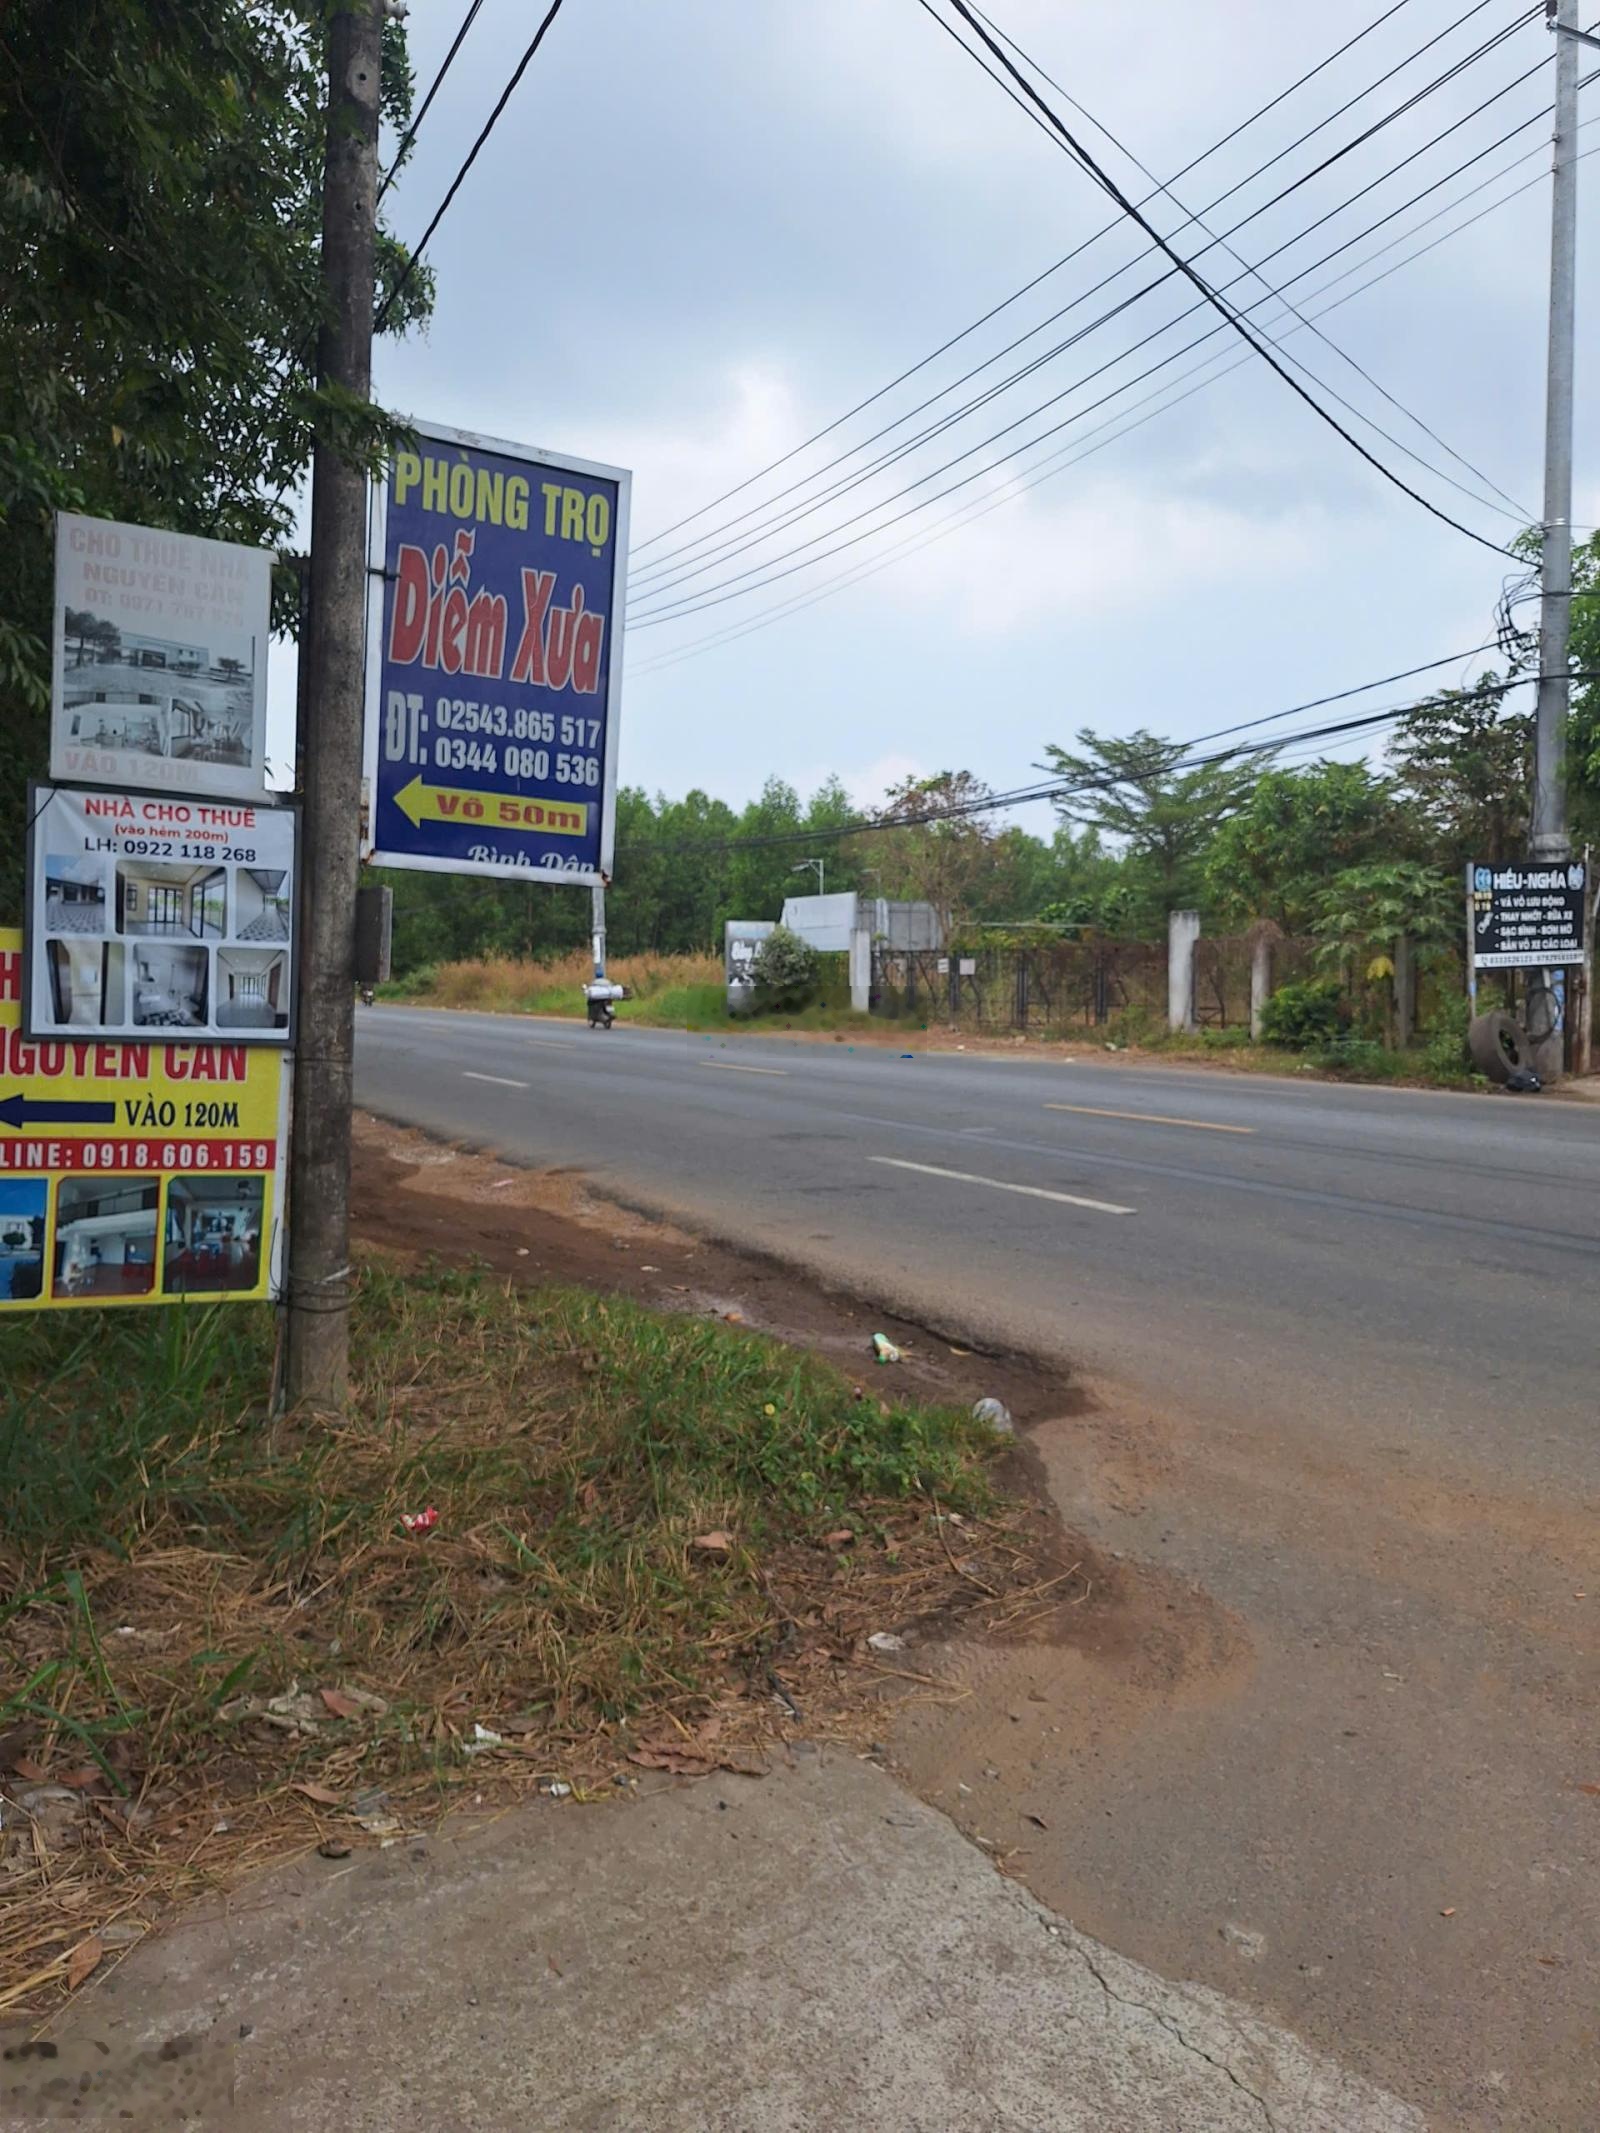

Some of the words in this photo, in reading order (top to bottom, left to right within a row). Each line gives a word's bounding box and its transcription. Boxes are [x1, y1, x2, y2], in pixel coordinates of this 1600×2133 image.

[395, 451, 530, 531] PHÒNG
[541, 483, 610, 557] TRỌ
[388, 527, 508, 680] Diễm
[509, 567, 605, 694] Xưa
[435, 697, 555, 743] 02543.865
[560, 715, 601, 749] 517
[435, 737, 498, 774] 0344
[504, 745, 550, 780] 080
[555, 753, 600, 787] 536
[85, 796, 136, 819] NHÀ
[142, 804, 191, 824] CHO
[198, 808, 257, 829] THUÊ
[436, 793, 485, 819] Vô
[499, 801, 581, 831] 50m
[84, 836, 118, 854] LH:
[124, 839, 174, 858] 0922
[181, 844, 216, 861] 118
[222, 847, 257, 863] 268
[115, 823, 146, 837] (vào
[185, 829, 229, 844] 200m)
[124, 1092, 176, 1127] VÀO
[183, 1102, 240, 1129] 120M
[82, 1143, 269, 1168] 0918.606.159
